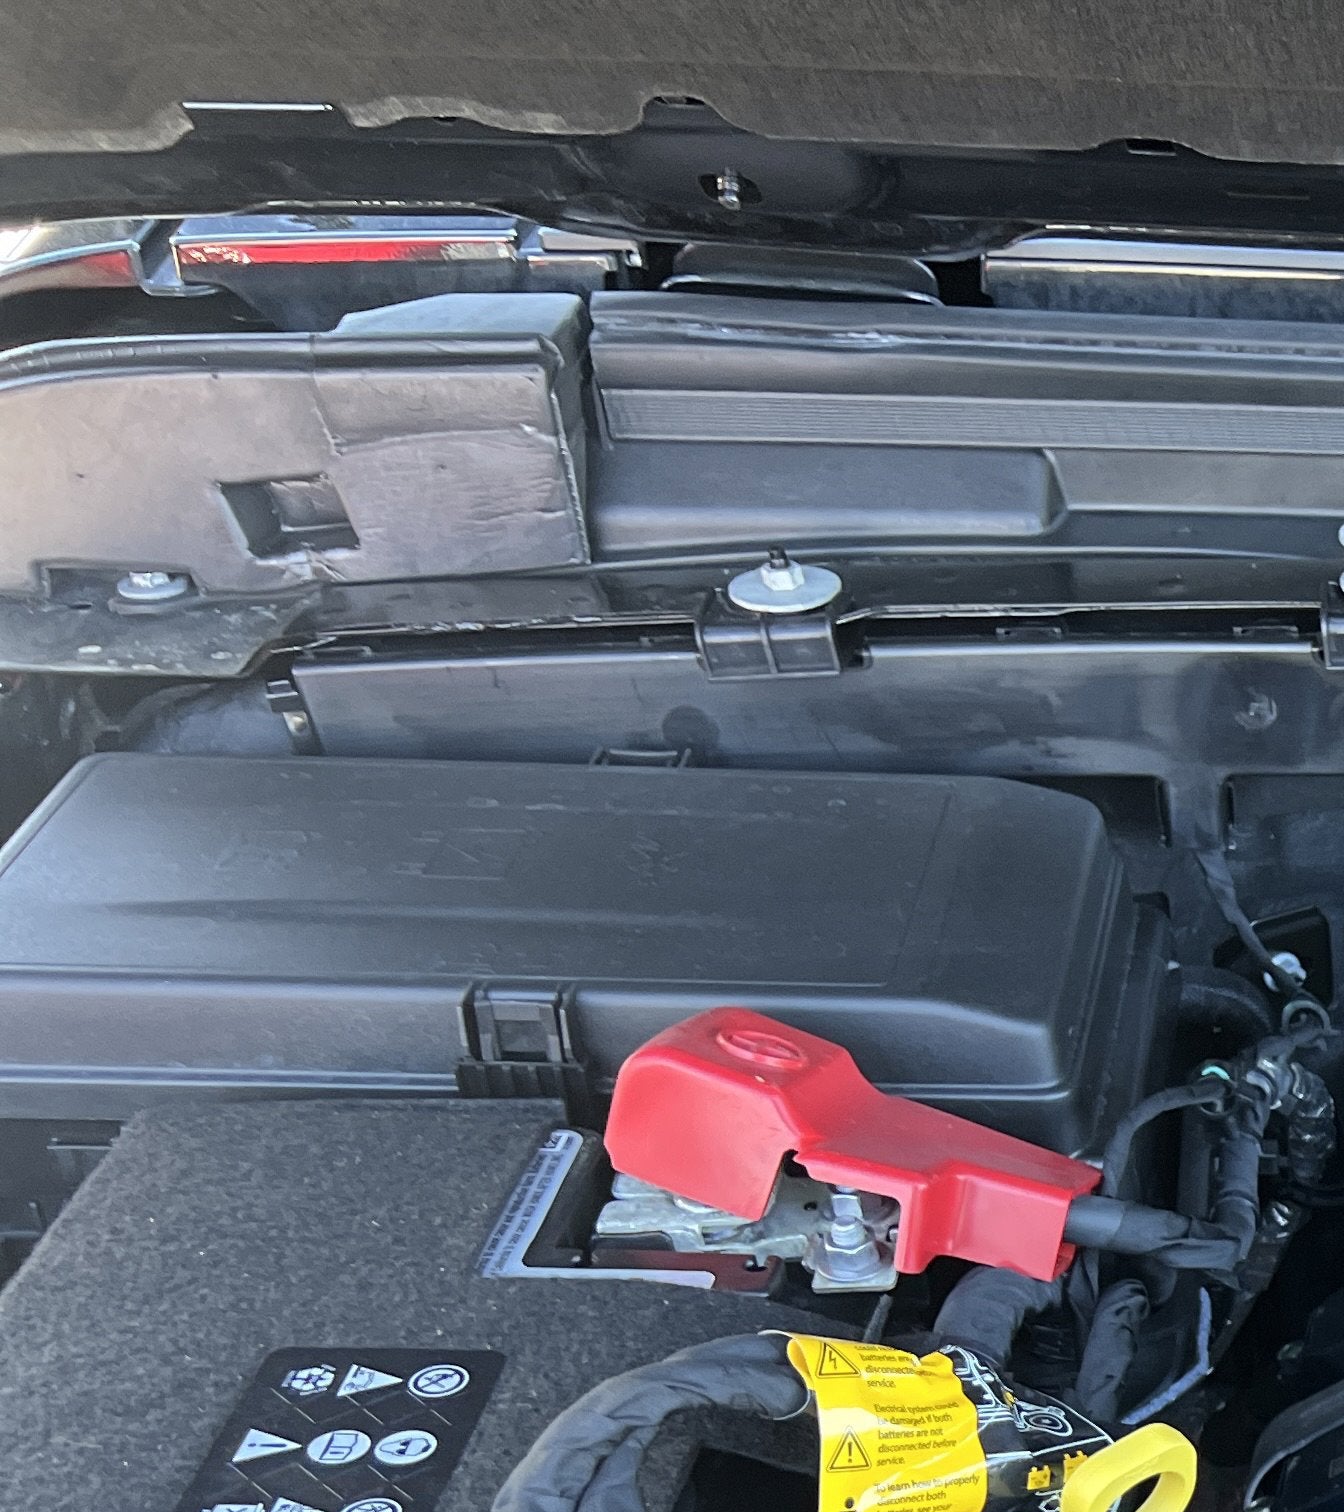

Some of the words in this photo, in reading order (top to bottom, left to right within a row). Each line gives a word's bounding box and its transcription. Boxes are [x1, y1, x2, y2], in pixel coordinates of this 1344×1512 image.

[874, 1403, 906, 1413] Electrical
[878, 1430, 915, 1440] batteries
[930, 1428, 944, 1437] not
[878, 1440, 931, 1453] disconnected
[932, 1439, 957, 1449] before
[887, 1482, 911, 1492] learn
[944, 1473, 980, 1489] properly
[877, 1495, 924, 1507] disconnect
[926, 1490, 947, 1502] both
